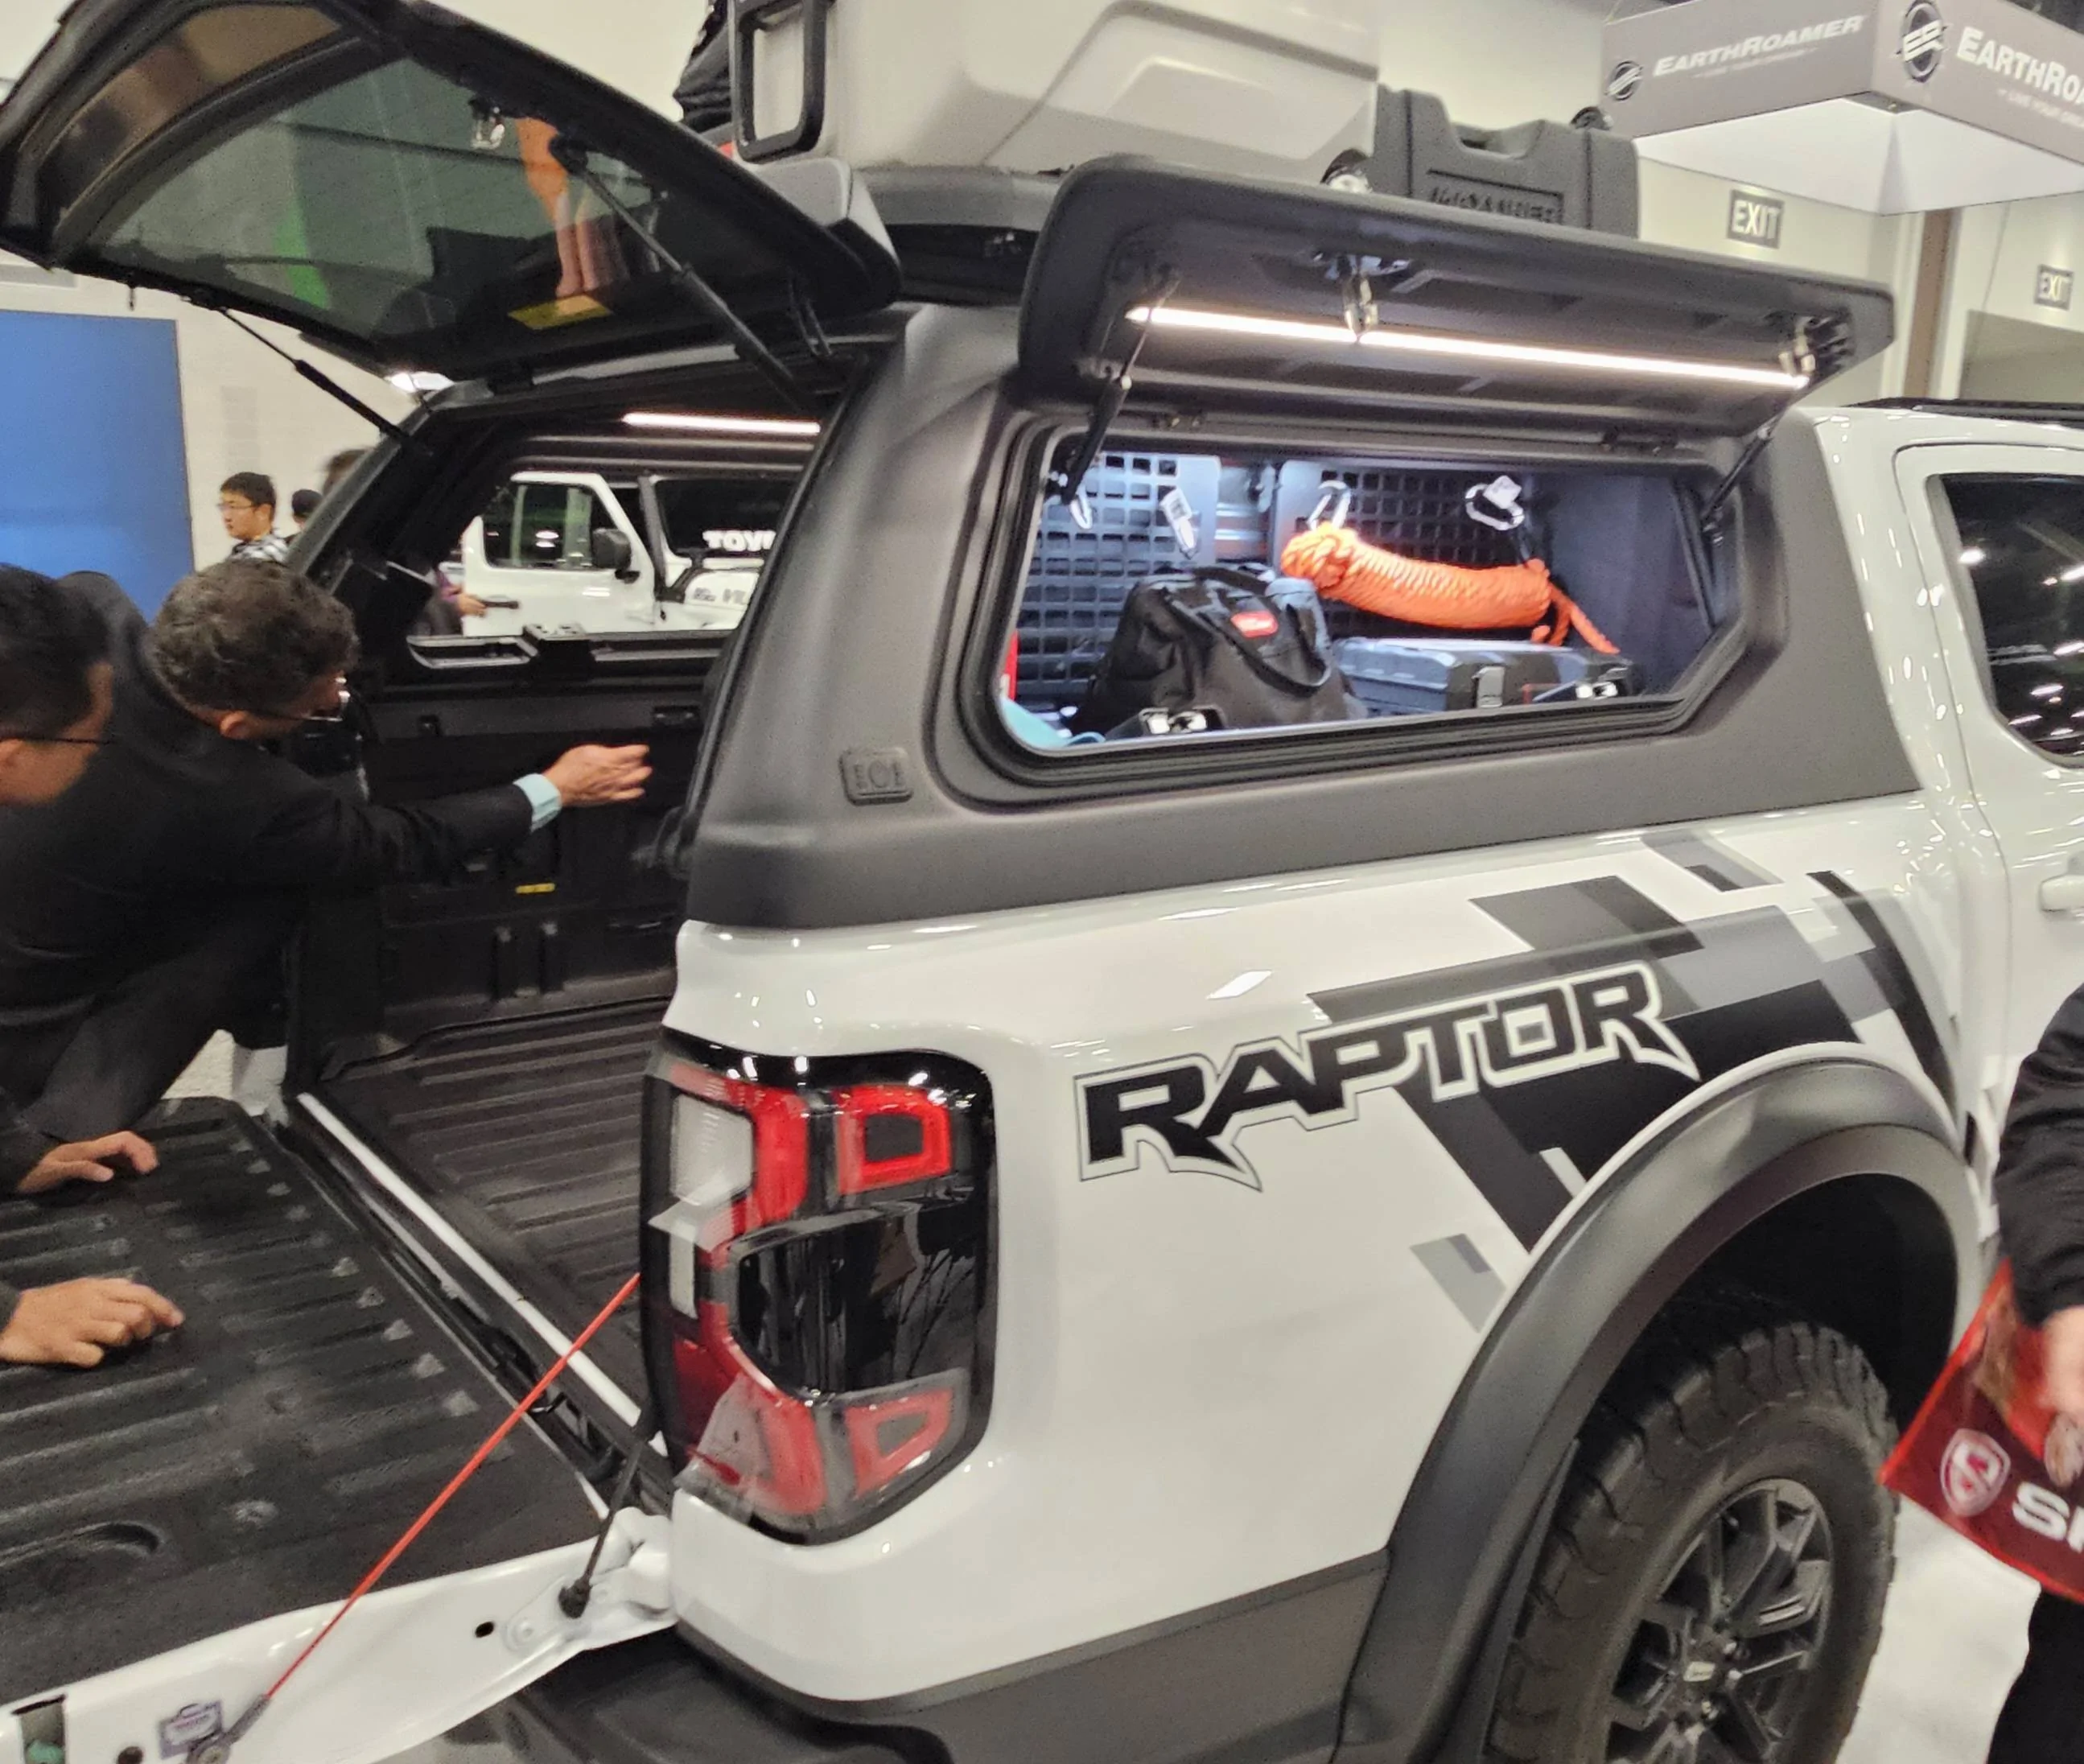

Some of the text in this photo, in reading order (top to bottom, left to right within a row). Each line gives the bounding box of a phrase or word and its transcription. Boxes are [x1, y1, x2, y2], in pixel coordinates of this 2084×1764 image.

[1652, 14, 1864, 77] EARTHROAMER
[1731, 200, 1781, 239] EXIT
[2038, 272, 2071, 301] EXIT
[1074, 961, 1699, 1192] RAPTOR
